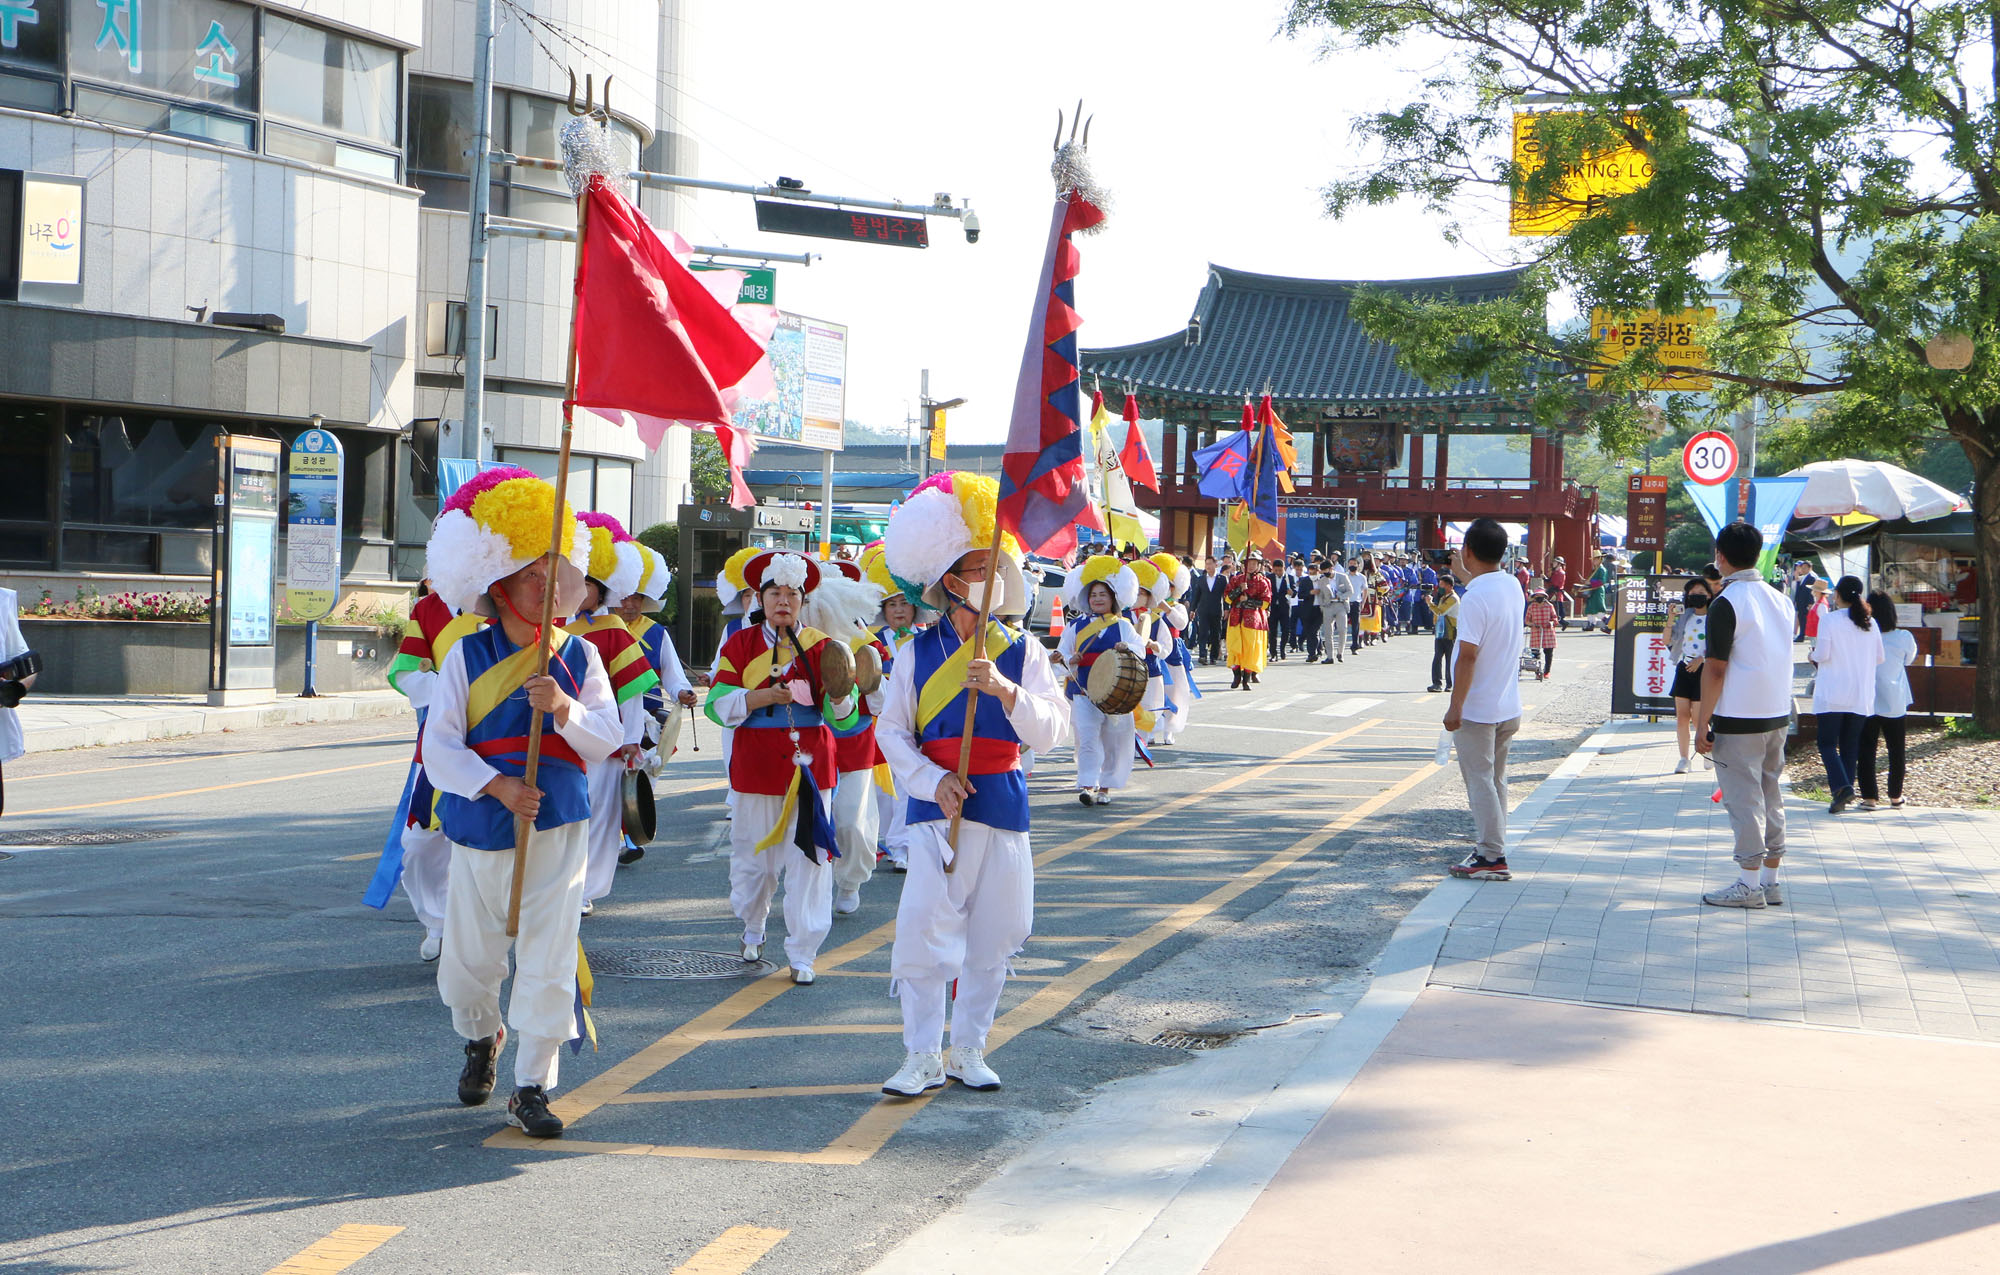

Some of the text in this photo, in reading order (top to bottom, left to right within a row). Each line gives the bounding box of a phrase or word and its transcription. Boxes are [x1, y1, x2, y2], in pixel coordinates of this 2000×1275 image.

[1532, 163, 1657, 178] PRKING LO
[1621, 322, 1692, 346] 공중화장
[1663, 350, 1703, 359] TOILETS
[303, 456, 326, 465] 금성관
[1694, 446, 1726, 469] 30
[1644, 480, 1665, 488] 나주시
[713, 512, 731, 523] IBK
[1626, 578, 1647, 588] 2nd
[1626, 590, 1647, 601] 천년
[1625, 601, 1669, 614] 읍성문화
[1646, 638, 1667, 694] 주차장
